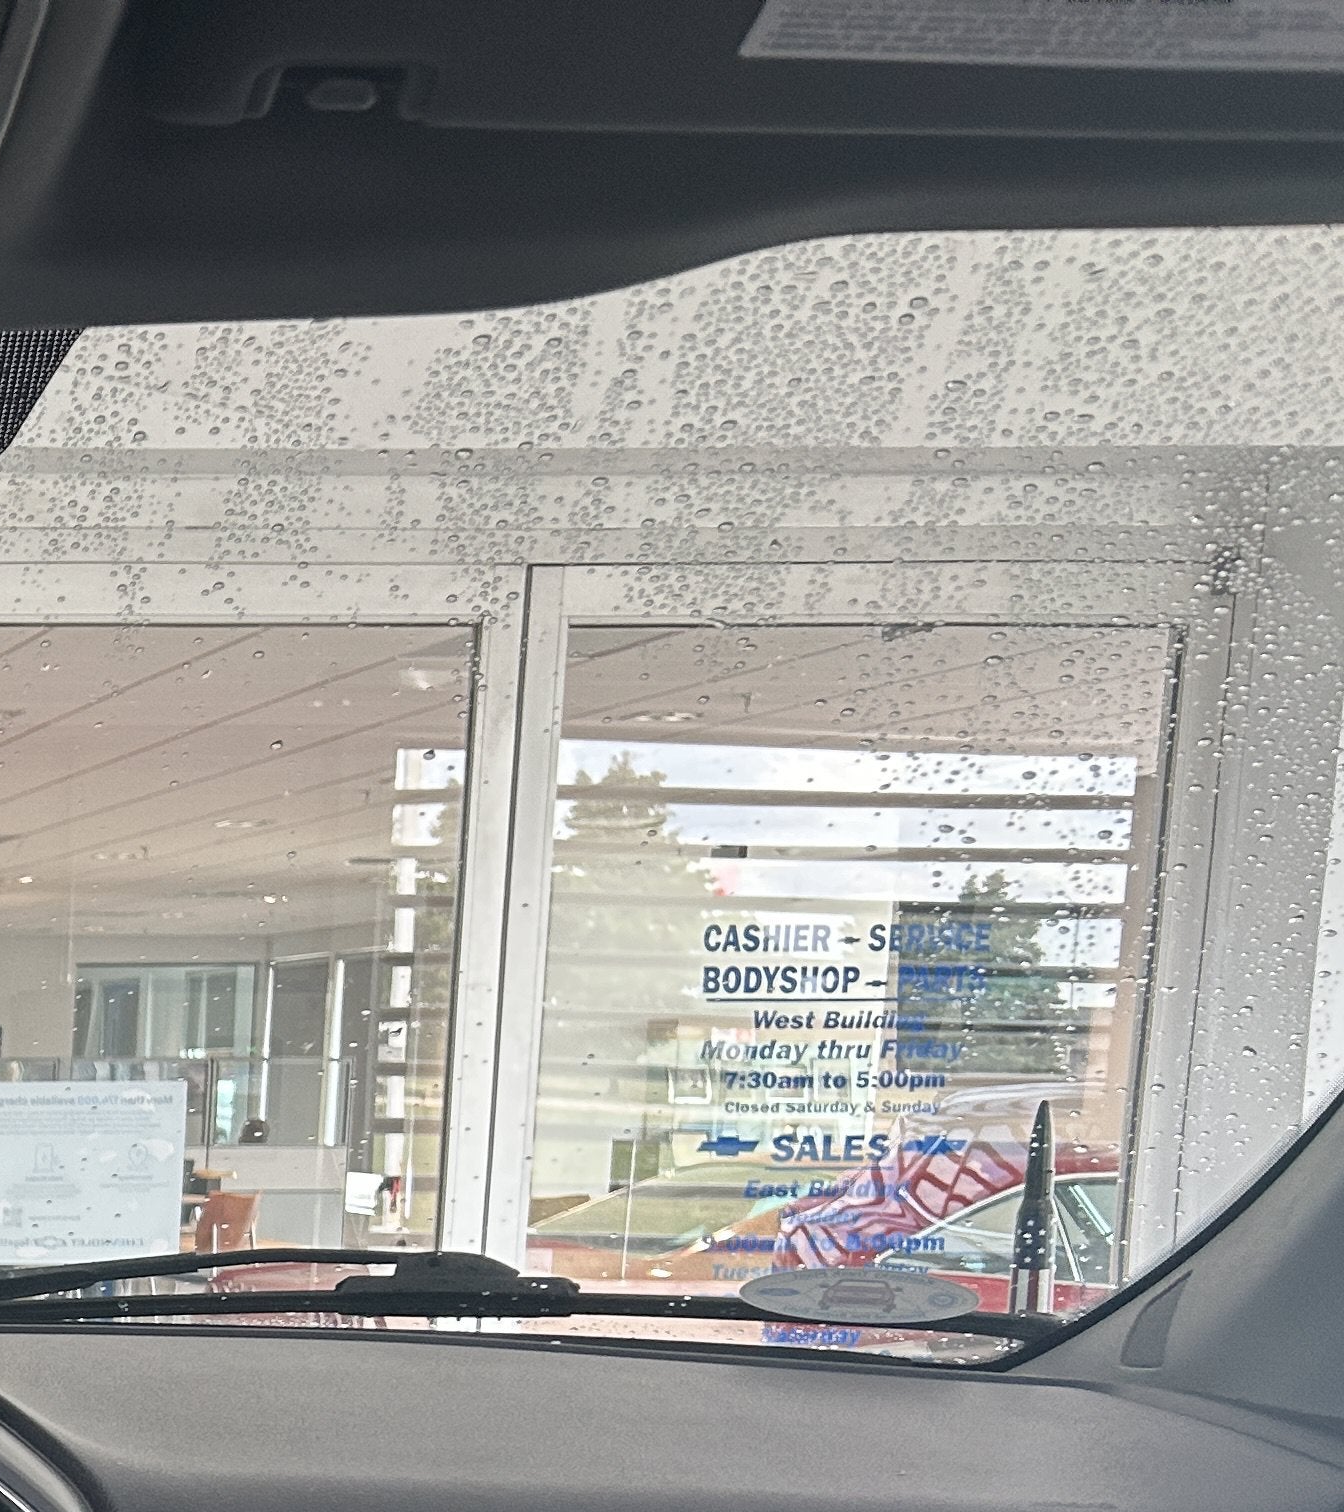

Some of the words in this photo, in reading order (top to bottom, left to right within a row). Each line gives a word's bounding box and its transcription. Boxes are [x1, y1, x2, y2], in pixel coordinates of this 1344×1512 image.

[703, 923, 832, 953] CASHIER
[868, 923, 992, 952] SERVICE
[702, 965, 861, 994] BODYSHOP
[898, 965, 986, 993] PARTS
[753, 1010, 816, 1030] West
[823, 1009, 927, 1033] Building
[700, 1040, 809, 1065] Monday
[817, 1039, 870, 1059] thru
[880, 1039, 963, 1062] Friday
[724, 1070, 813, 1090] 7:30am
[822, 1070, 848, 1089] to
[856, 1070, 945, 1092] 5:00pm
[724, 1101, 780, 1114] Closed
[785, 1101, 858, 1116] Saturday
[863, 1101, 876, 1114] &
[882, 1101, 941, 1116] Sunday
[771, 1134, 890, 1162] SALES
[744, 1180, 801, 1199] East
